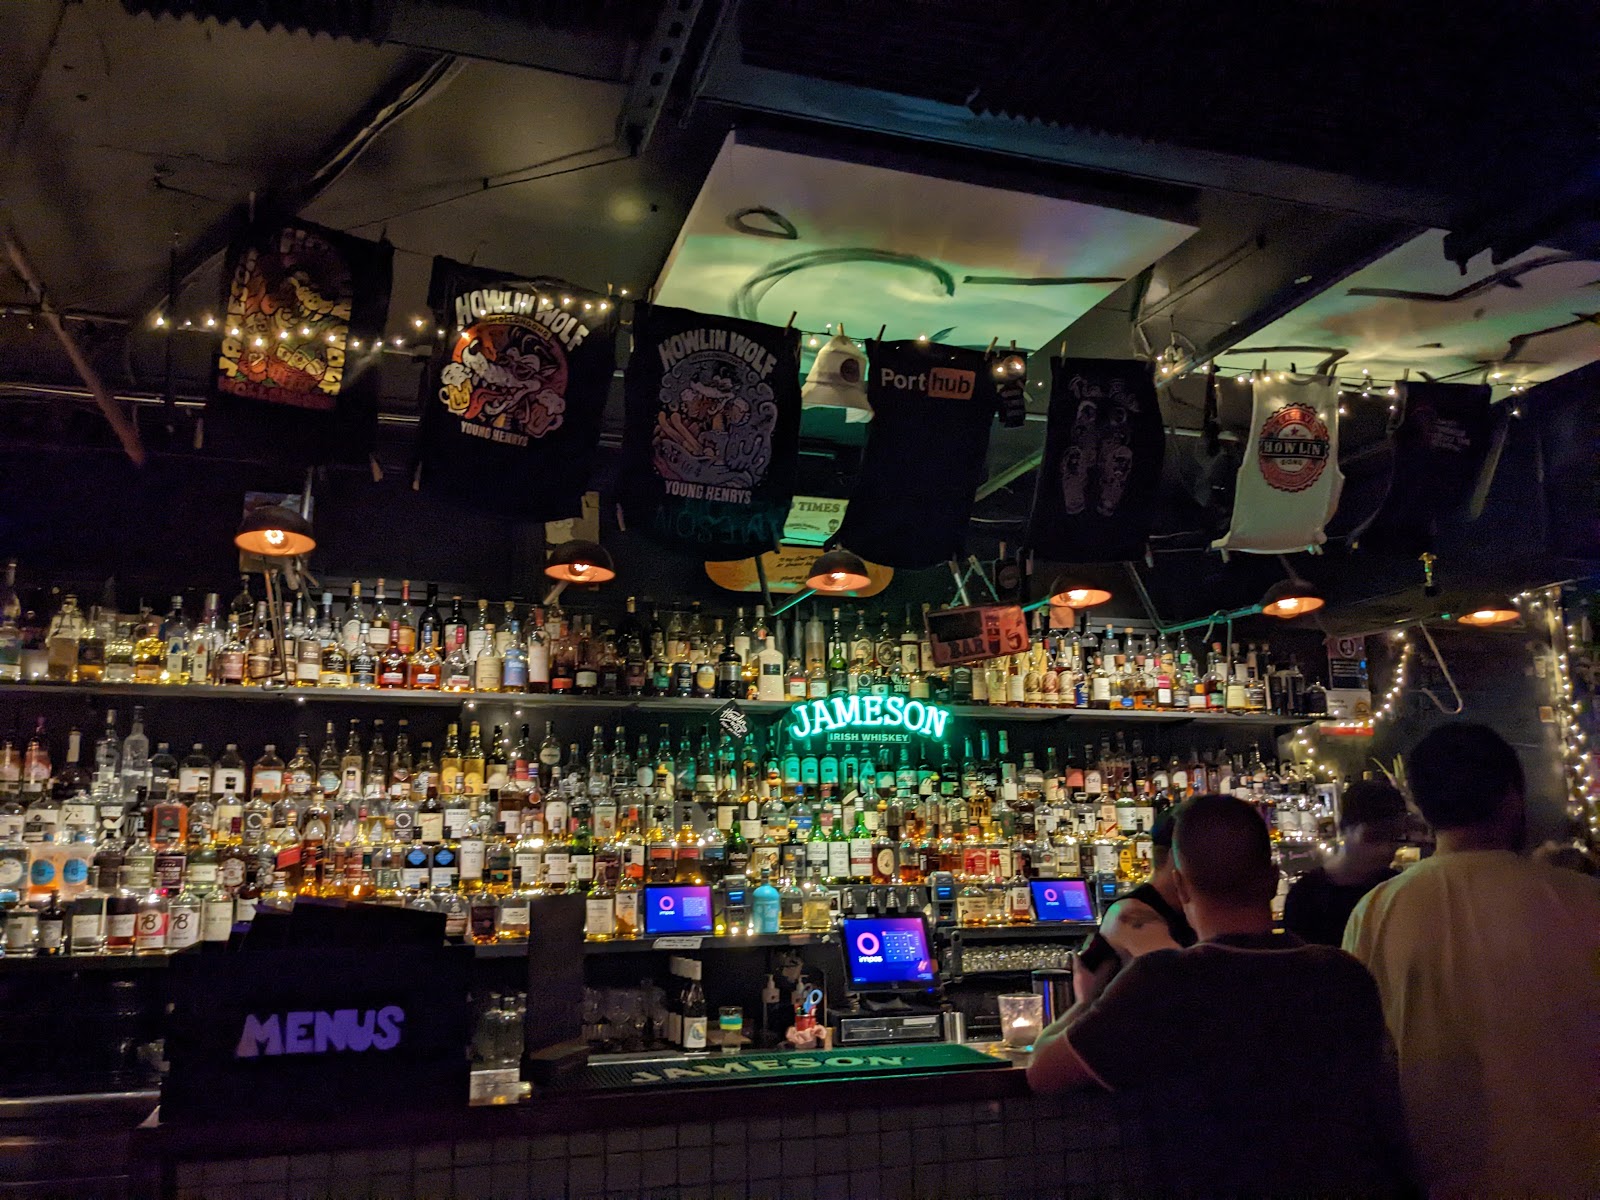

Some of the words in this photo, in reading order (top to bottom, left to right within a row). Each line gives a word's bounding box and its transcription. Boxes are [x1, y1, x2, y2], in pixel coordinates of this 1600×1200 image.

[455, 289, 536, 331] HOWLIN
[535, 303, 590, 352] WOLF
[658, 329, 727, 371] HOWLIN
[728, 331, 778, 380] WOLF
[881, 367, 926, 391] Port
[932, 371, 972, 394] hub
[461, 421, 491, 440] YOUNG
[491, 427, 530, 447] HENRYS
[665, 480, 703, 500] YOUNG
[705, 486, 752, 505] HENRYS
[798, 501, 841, 513] TIMES
[791, 695, 949, 738] JAMESON
[829, 733, 859, 742] IRISH
[861, 733, 909, 743] WHISKEY
[235, 1005, 405, 1058] MENUS
[630, 1056, 903, 1084] JAMESON
